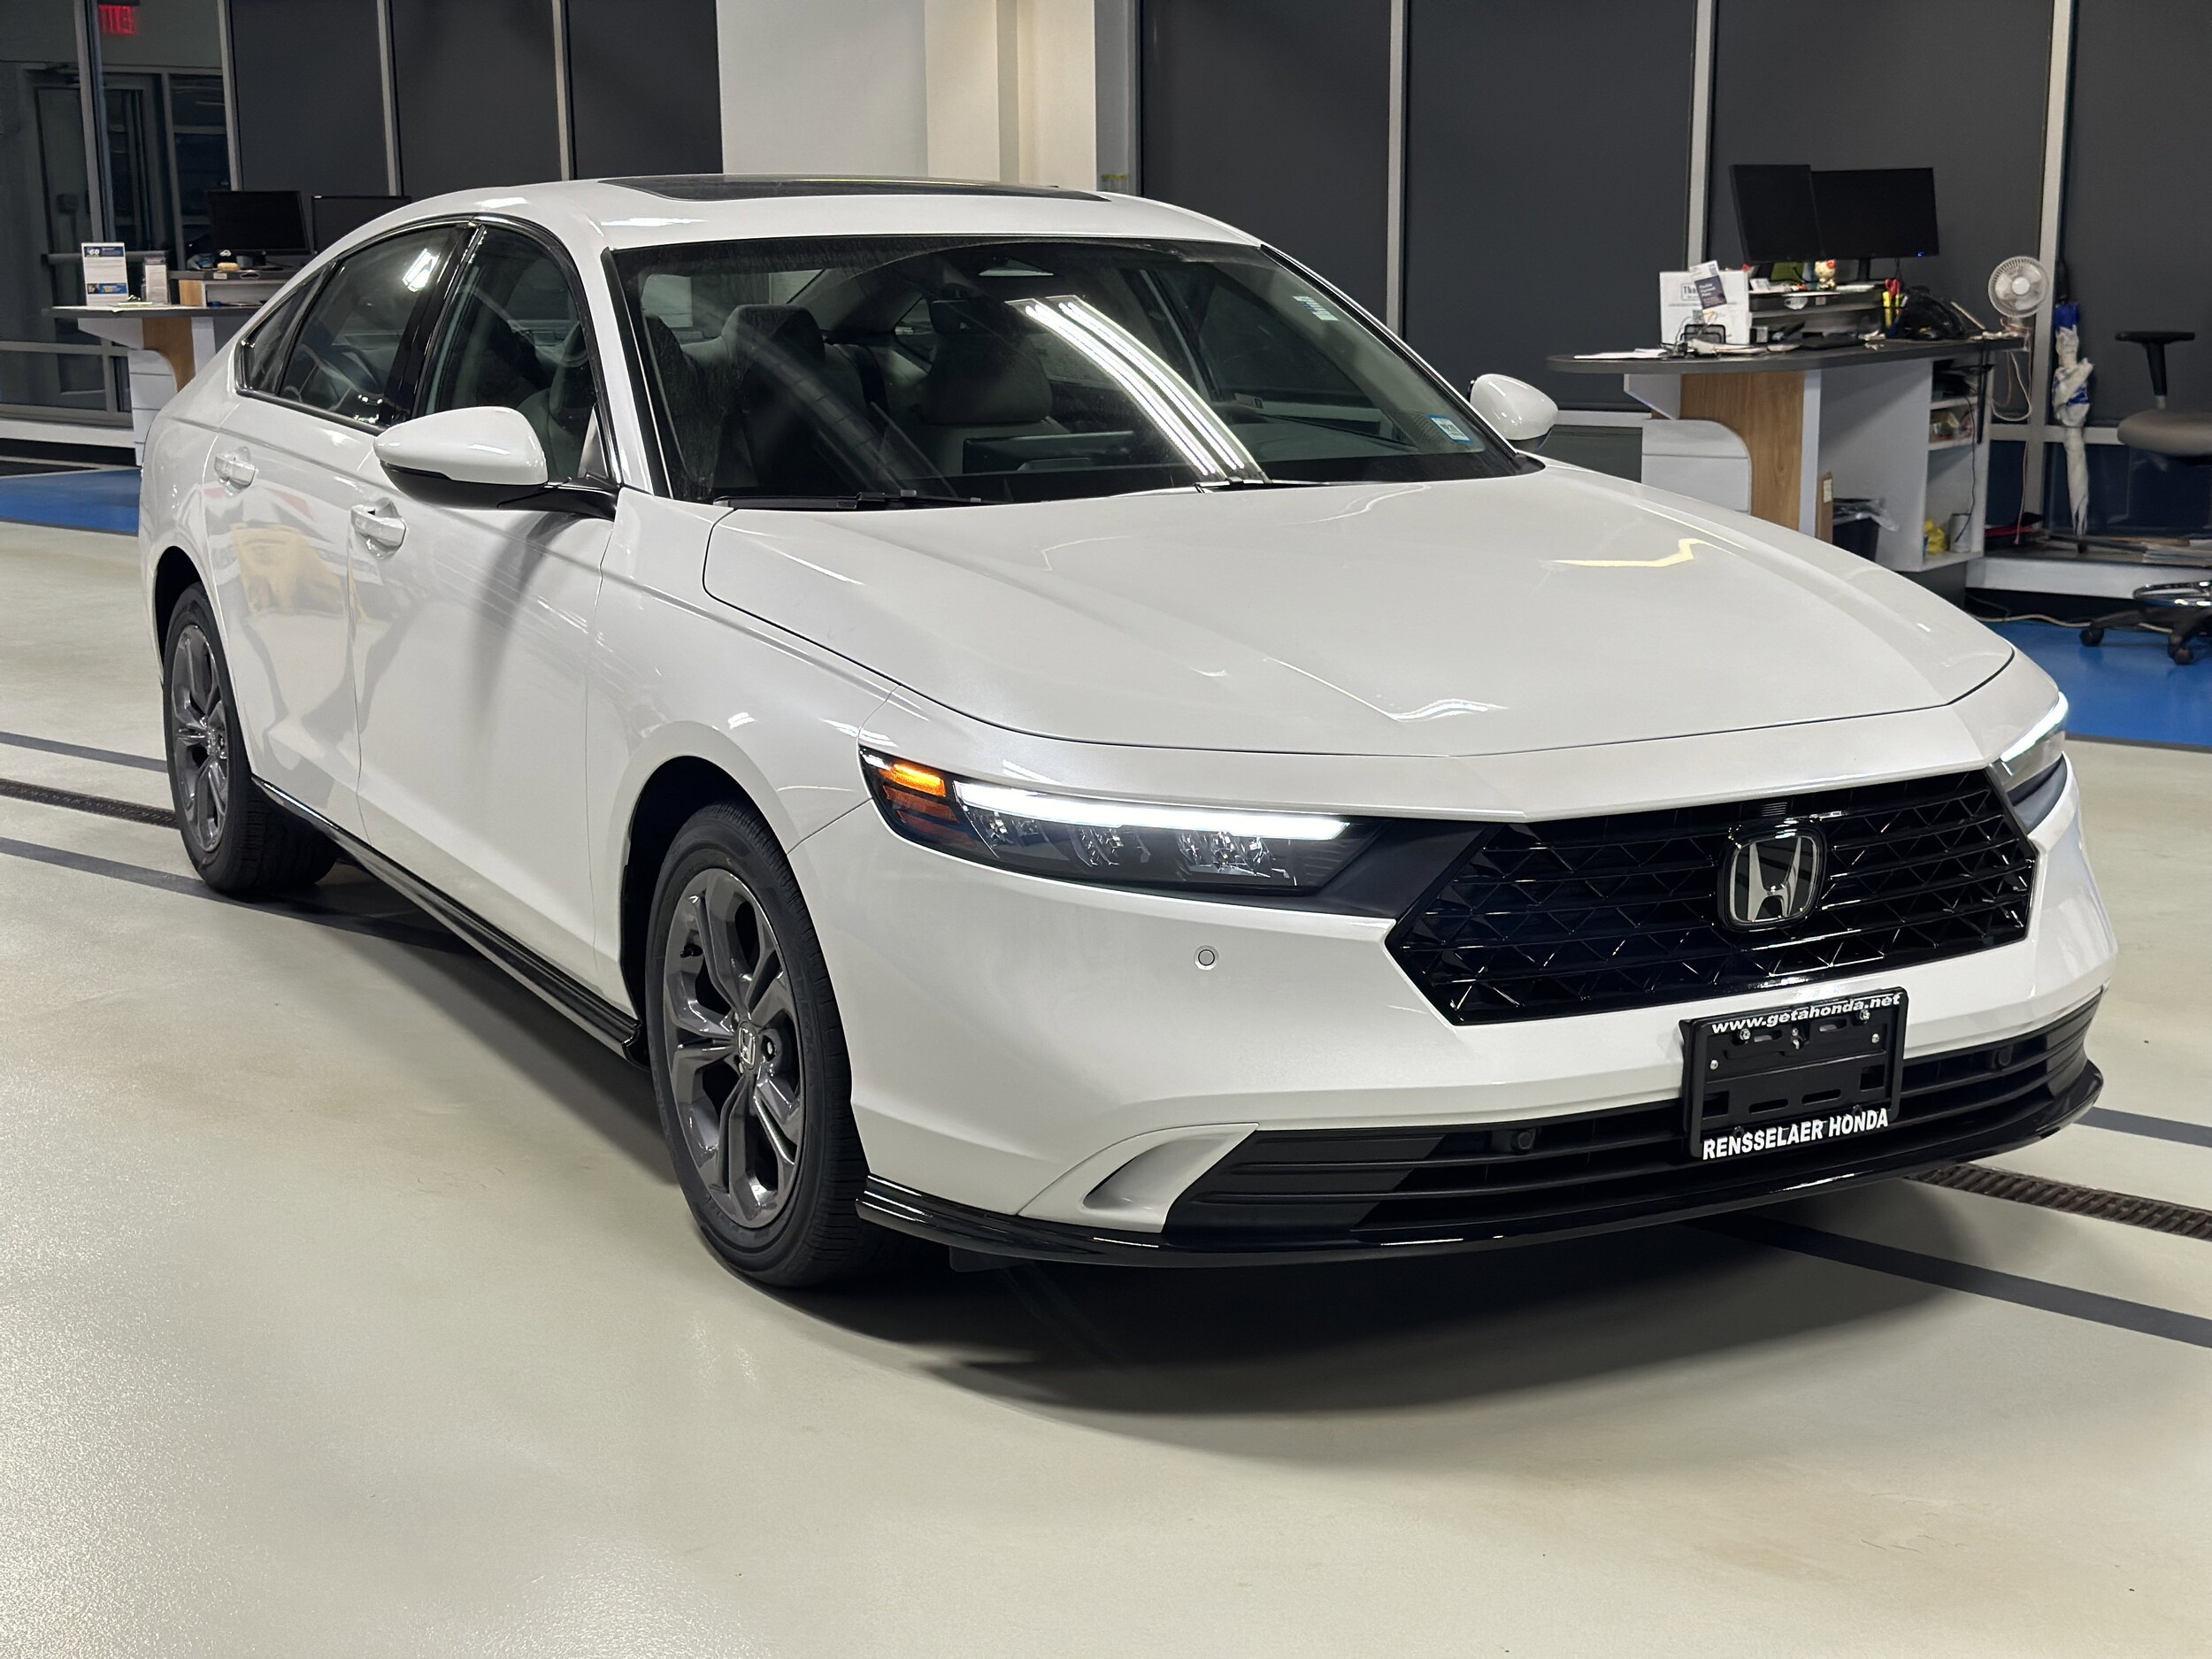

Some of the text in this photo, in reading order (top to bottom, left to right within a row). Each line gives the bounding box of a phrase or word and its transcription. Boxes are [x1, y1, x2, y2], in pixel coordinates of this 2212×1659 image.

[1711, 993, 1901, 1034] www.getahonda.net
[1702, 1108, 1888, 1160] RENSSELAER HONDA
